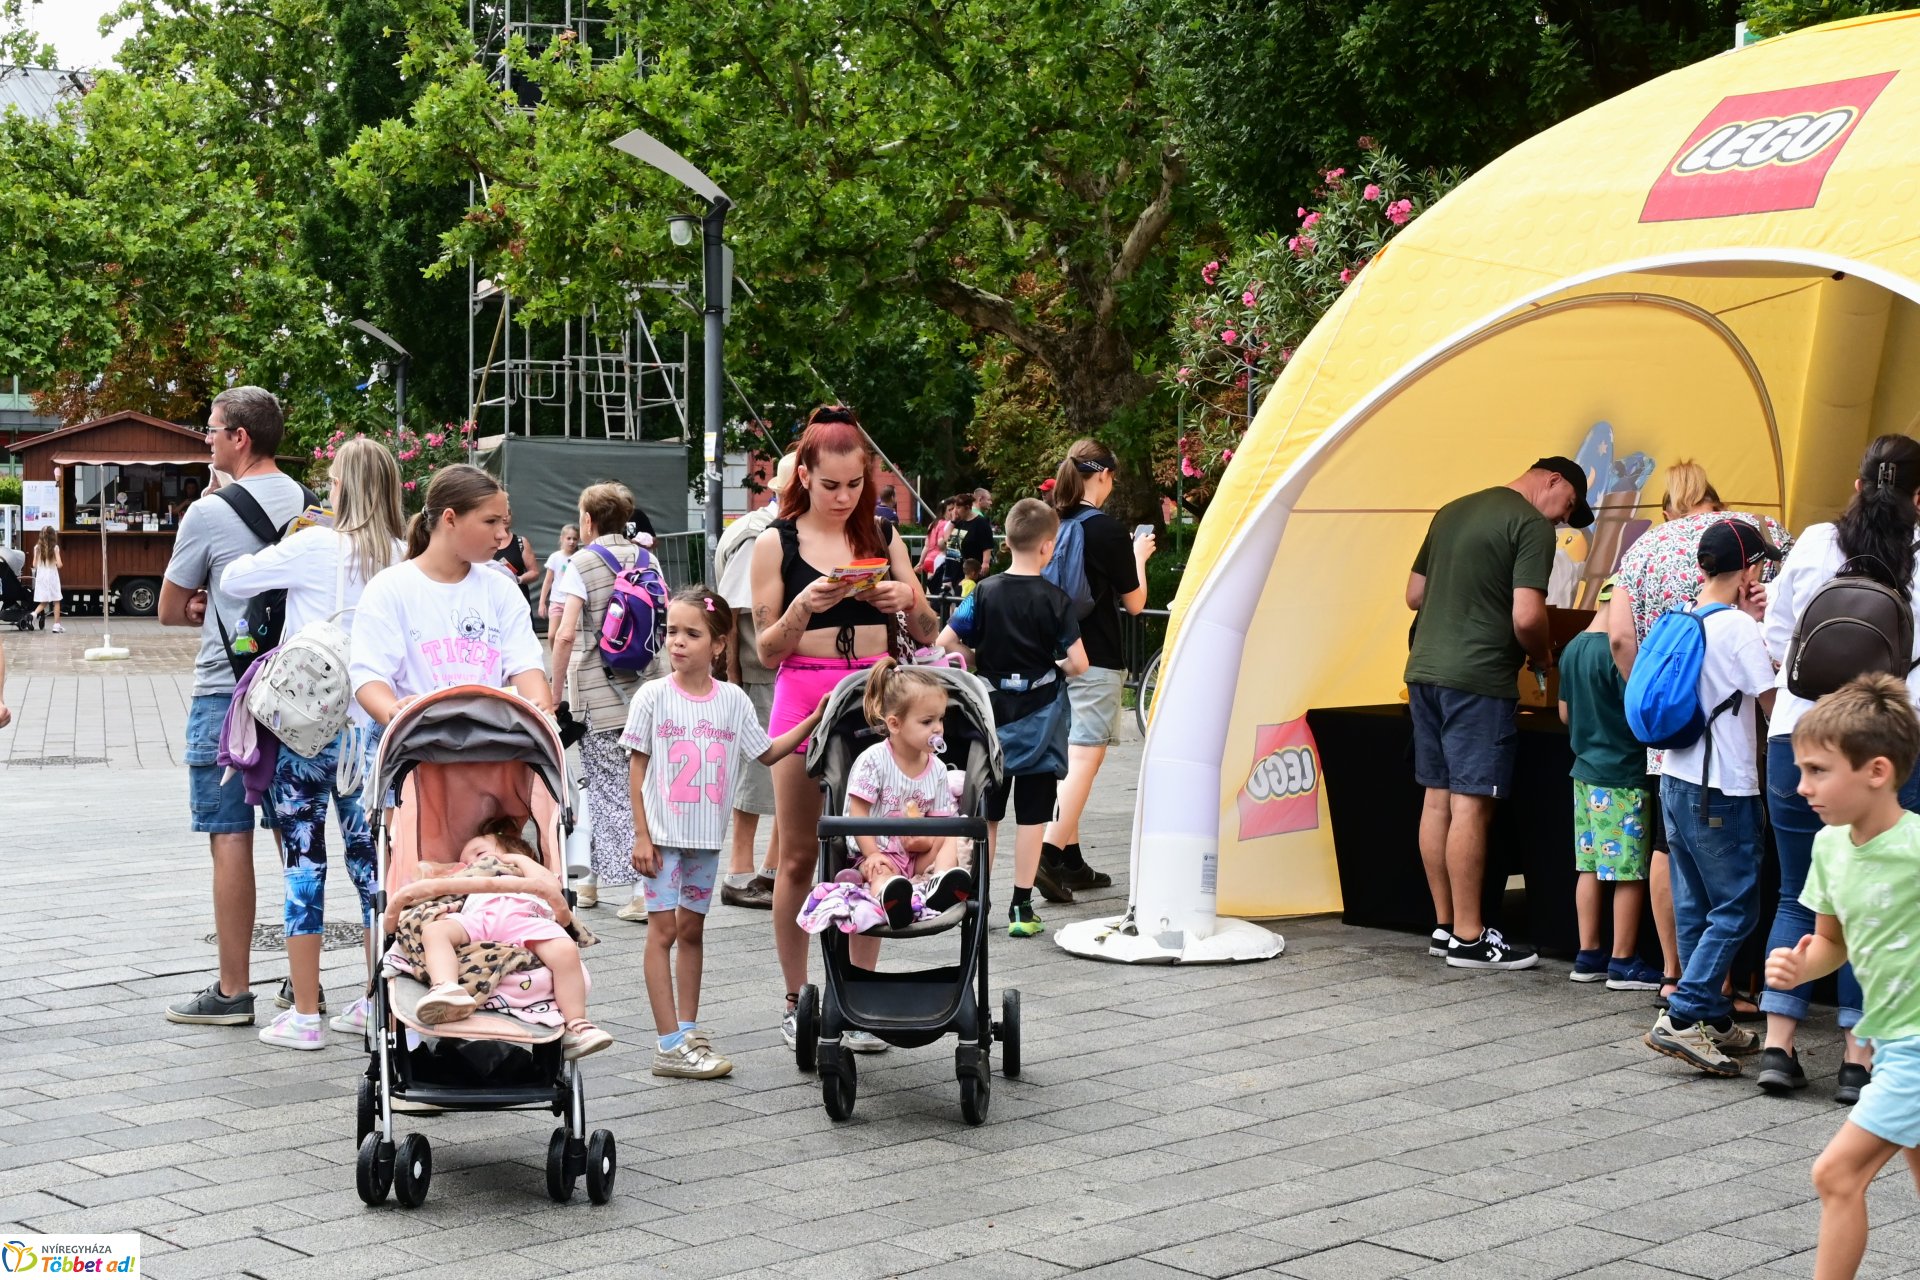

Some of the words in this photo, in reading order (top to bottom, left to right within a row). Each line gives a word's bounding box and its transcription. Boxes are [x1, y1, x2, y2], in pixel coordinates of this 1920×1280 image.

[1676, 109, 1854, 174] LEGO
[657, 719, 687, 738] Los
[667, 739, 727, 805] 23
